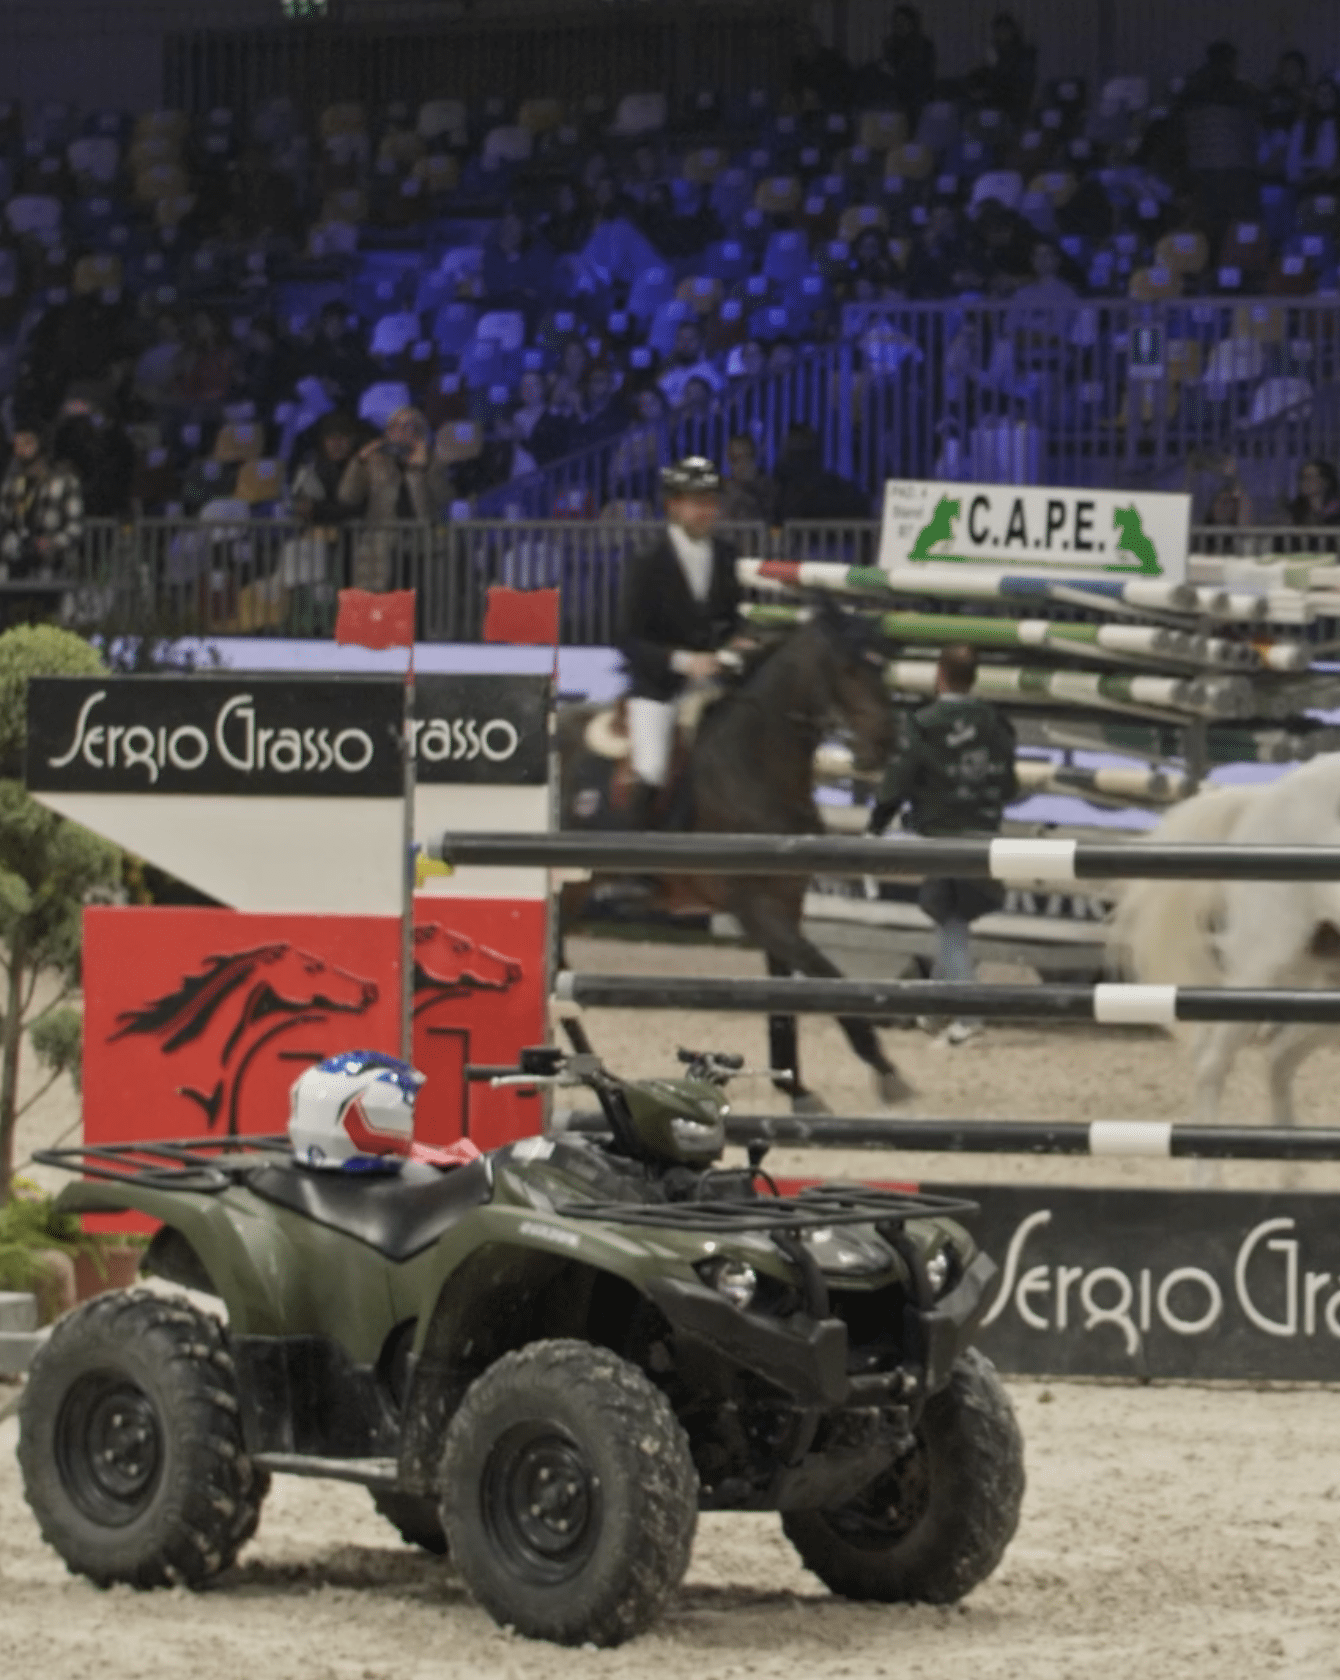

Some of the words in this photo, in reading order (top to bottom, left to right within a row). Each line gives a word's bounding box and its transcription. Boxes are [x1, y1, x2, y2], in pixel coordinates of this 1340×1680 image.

[967, 495, 1106, 552] C.A.P.E.
[49, 691, 209, 783] Sergio
[215, 694, 375, 773] Grasso
[408, 717, 519, 762] rasso
[978, 1209, 1223, 1355] Sergio
